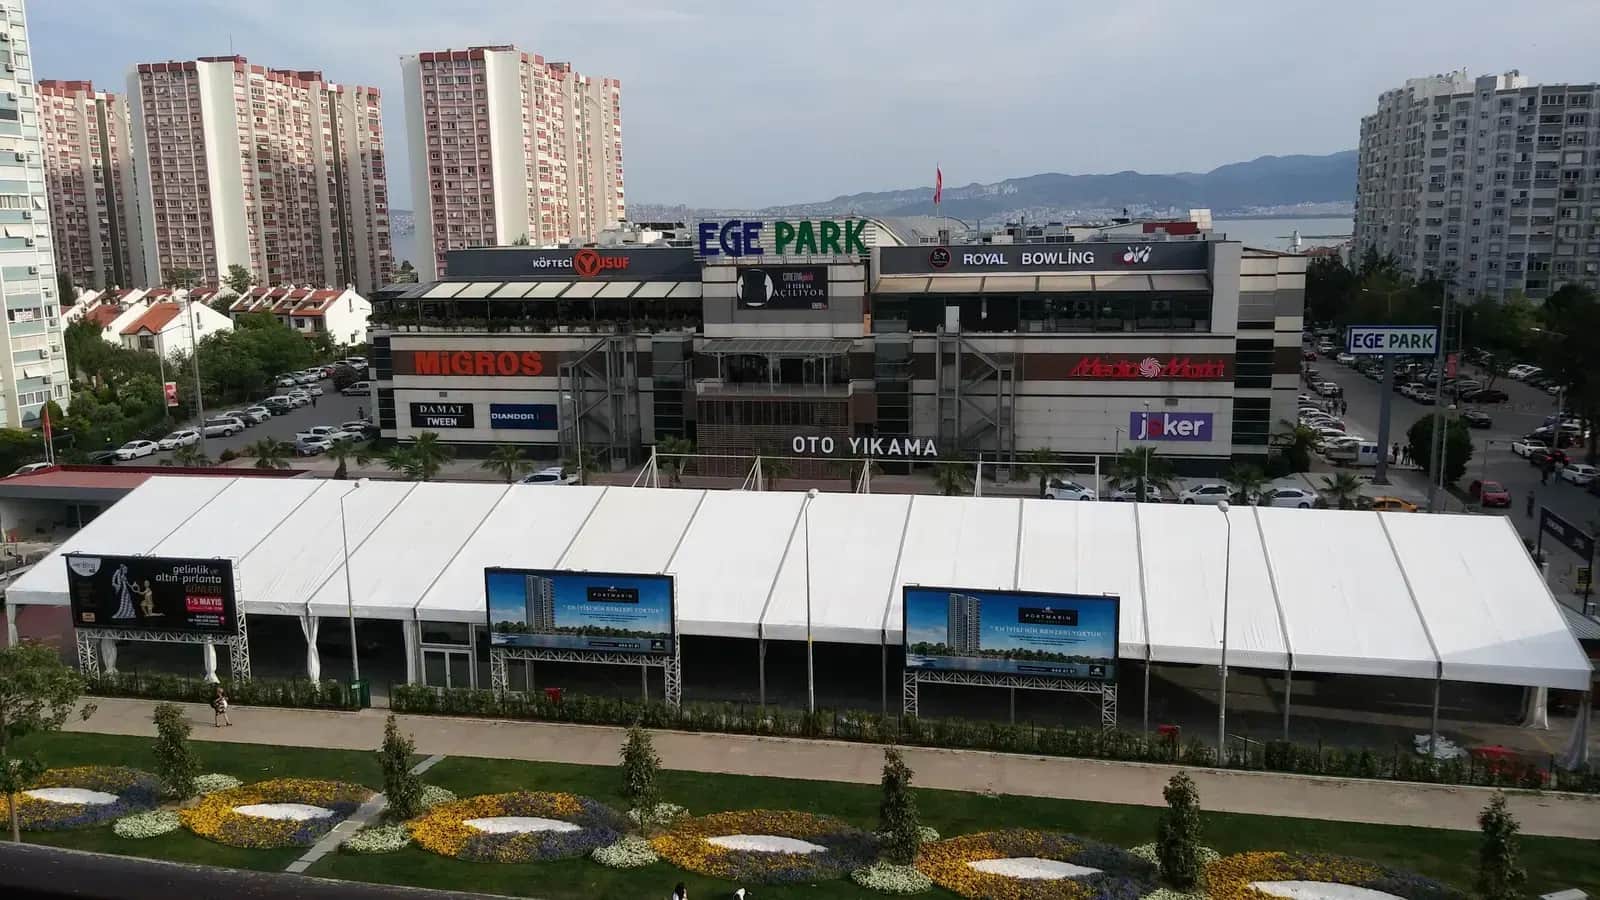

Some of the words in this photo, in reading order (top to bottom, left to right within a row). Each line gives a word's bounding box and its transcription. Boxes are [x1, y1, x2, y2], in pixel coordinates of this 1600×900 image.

[698, 219, 764, 257] EGE
[774, 219, 872, 255] PARK
[575, 251, 631, 276] YUSUF
[963, 253, 1008, 265] ROYAL
[1353, 332, 1385, 349] EGE
[1388, 333, 1434, 349] PARK
[419, 405, 464, 414] DAMAT
[426, 417, 458, 427] TWEEN
[1137, 412, 1205, 440] joker
[792, 436, 834, 454] OTO
[848, 436, 939, 457] YIKAMA
[173, 565, 209, 576] gelinlik
